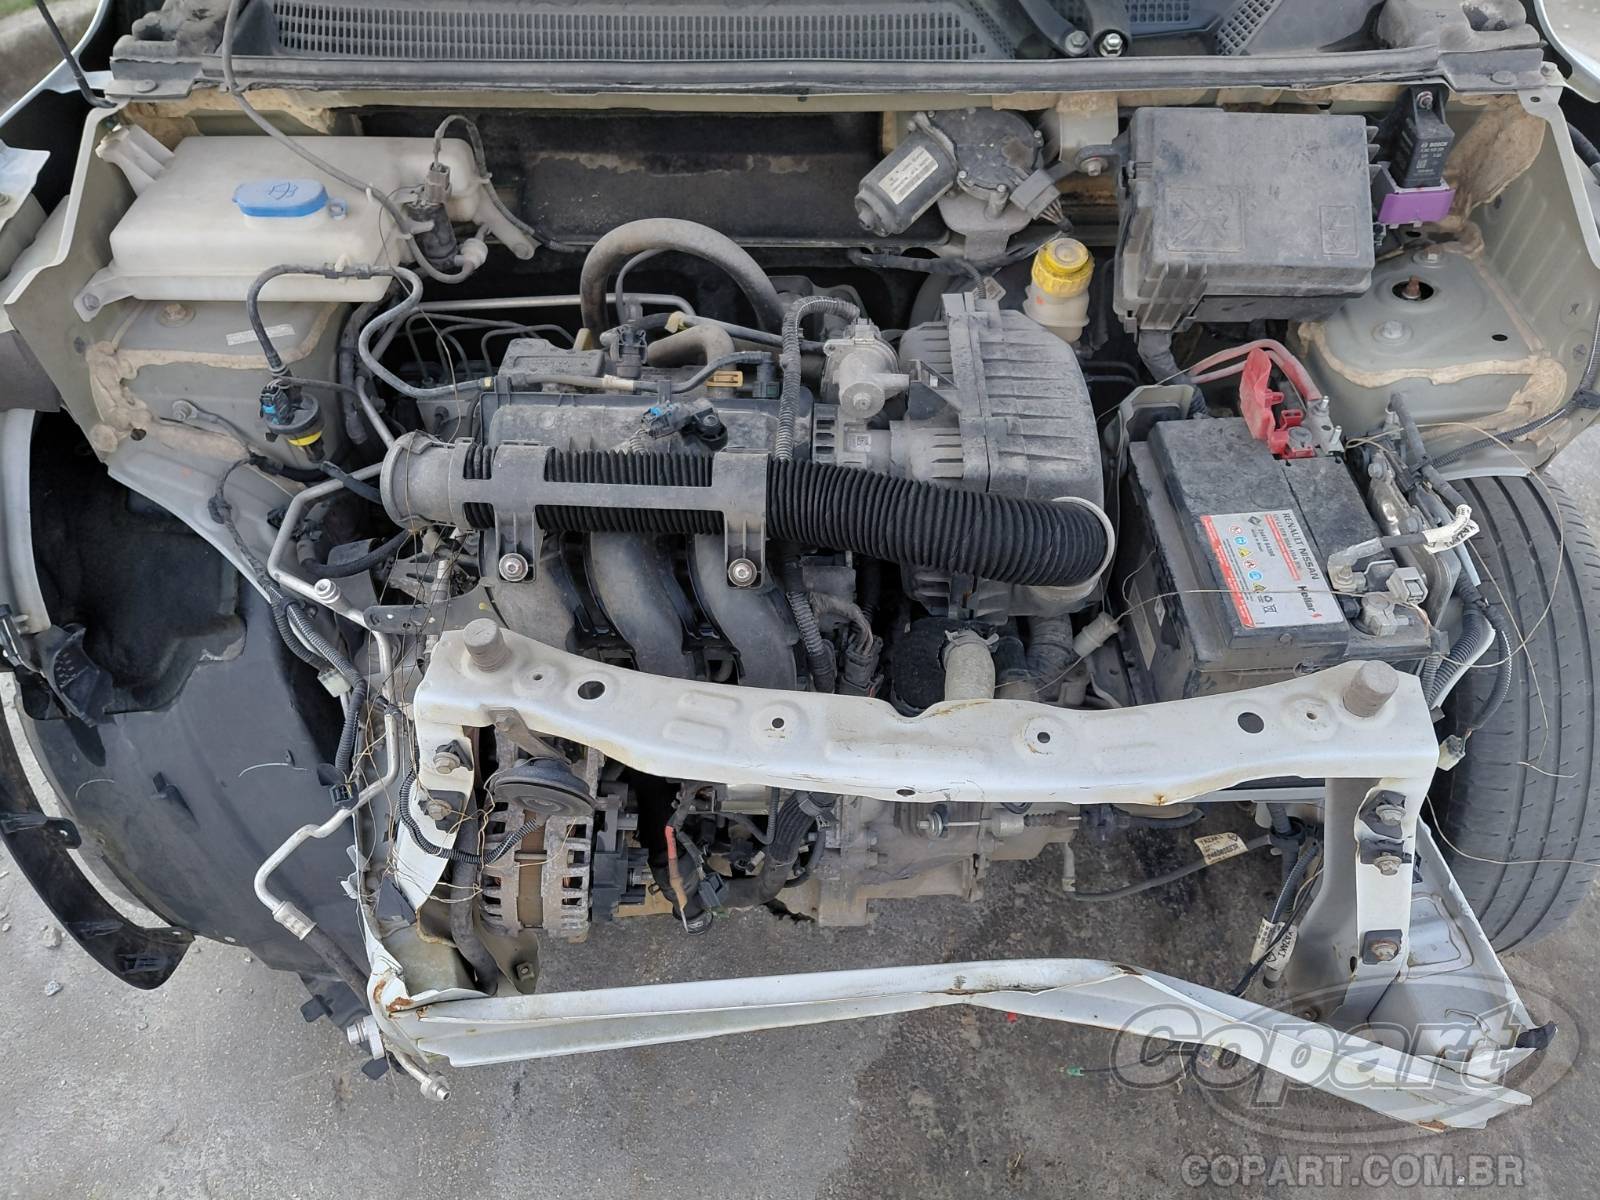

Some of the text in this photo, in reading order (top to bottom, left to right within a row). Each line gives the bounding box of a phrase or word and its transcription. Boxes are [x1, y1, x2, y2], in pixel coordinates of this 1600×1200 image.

[1282, 513, 1303, 545] RENAULT
[1298, 548, 1319, 580] NISSAN
[1296, 586, 1316, 612] Heliar
[1277, 931, 1294, 958] YAZAKI
